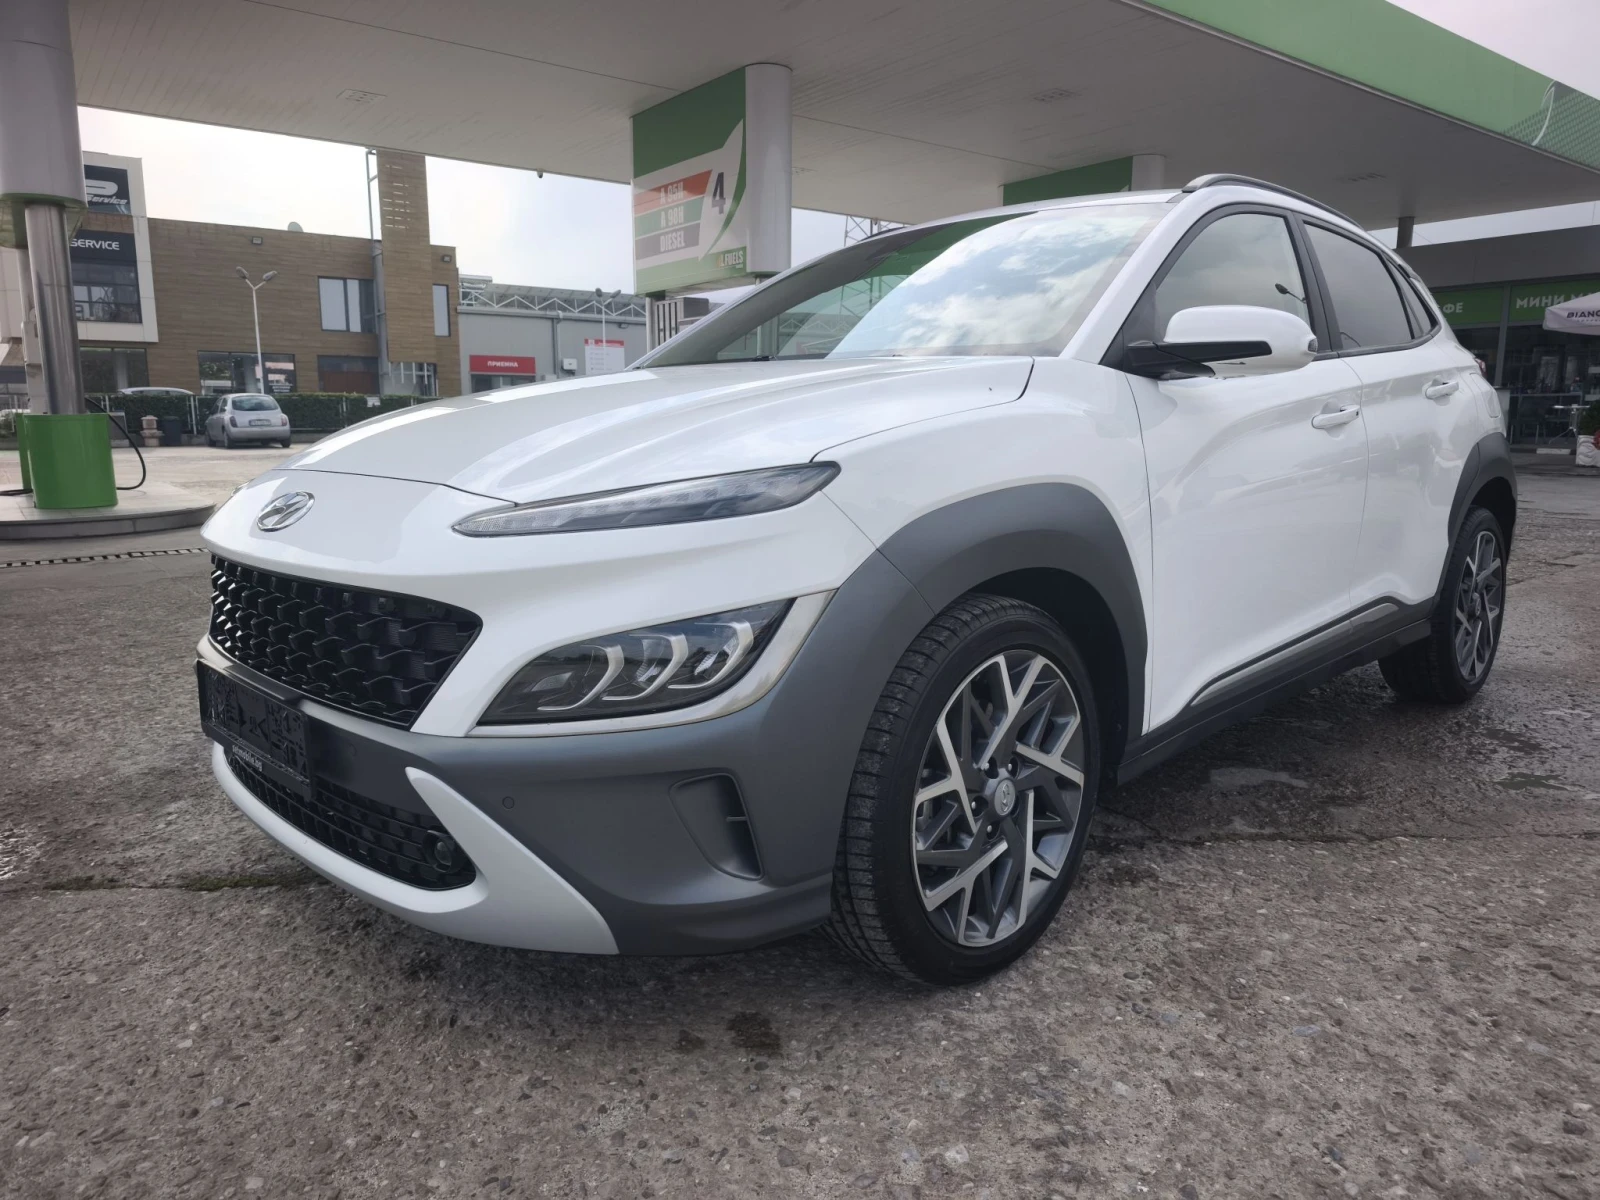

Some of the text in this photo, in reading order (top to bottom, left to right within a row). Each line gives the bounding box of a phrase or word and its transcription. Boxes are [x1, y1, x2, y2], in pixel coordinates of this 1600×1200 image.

[712, 172, 726, 215] 4
[660, 211, 666, 228] A
[70, 239, 120, 251] SERVICE
[660, 230, 685, 252] DIESEL
[1516, 294, 1565, 309] МИНИ
[487, 360, 518, 368] ПРИЕМНА
